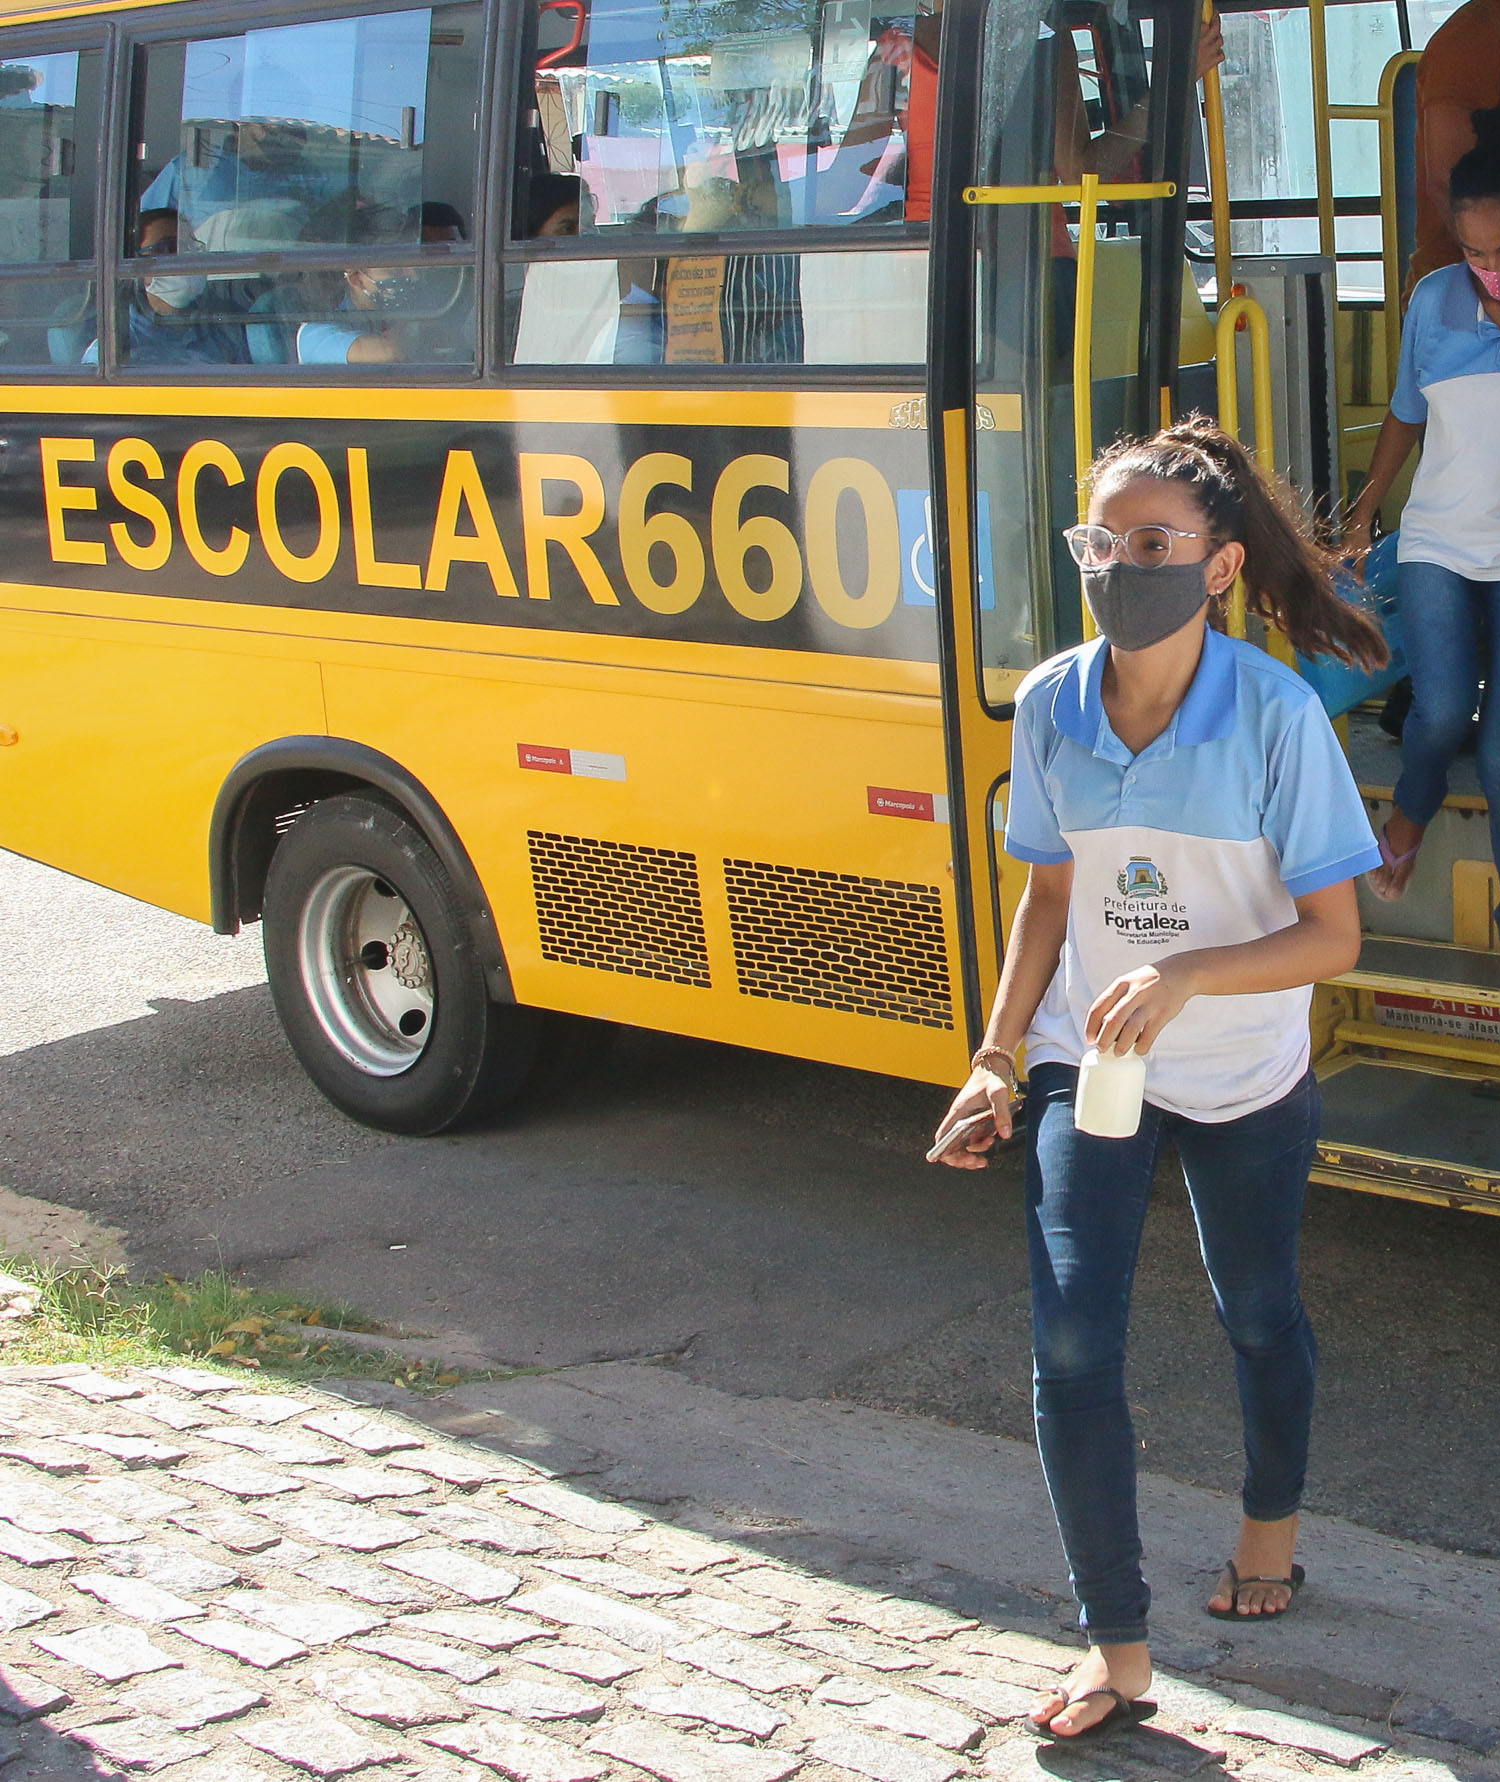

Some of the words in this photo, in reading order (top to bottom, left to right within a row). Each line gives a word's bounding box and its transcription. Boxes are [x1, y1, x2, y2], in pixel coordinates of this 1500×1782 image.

[1104, 896, 1167, 912] Prefeitura
[1171, 902, 1187, 913] de
[1104, 910, 1190, 931] Fortaleza
[1385, 1008, 1462, 1029] Mantenha-se
